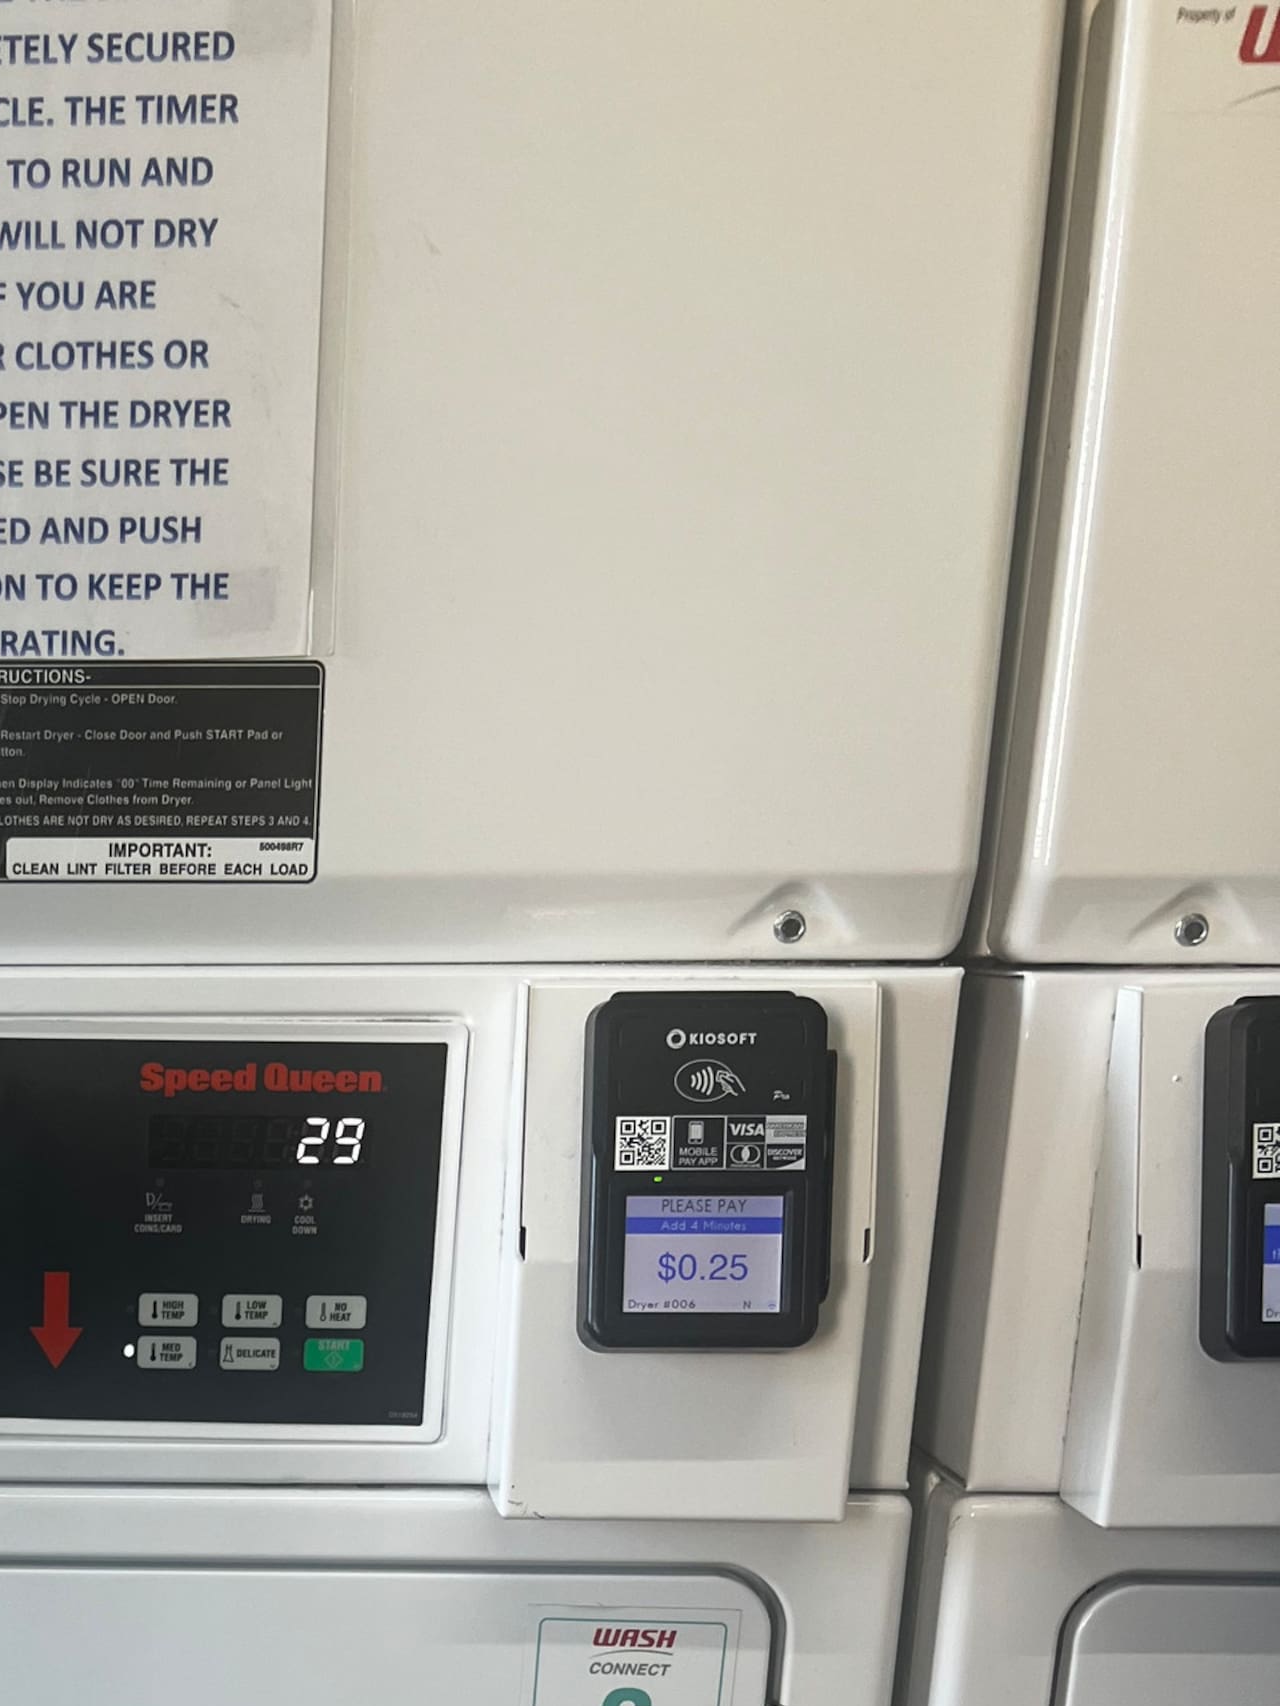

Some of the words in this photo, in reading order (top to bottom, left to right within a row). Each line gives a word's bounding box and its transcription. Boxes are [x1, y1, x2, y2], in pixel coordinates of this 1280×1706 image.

[88, 31, 235, 63] SECURED
[64, 96, 125, 125] THE
[136, 94, 238, 124] TIMER
[7, 159, 50, 188] TO
[63, 158, 130, 187] RUN
[142, 157, 213, 186] AND
[76, 219, 144, 248] NOT
[155, 218, 218, 247] DRY
[16, 281, 84, 310] YOU
[95, 280, 156, 309] ARE
[16, 340, 153, 370] CLOTHES
[164, 340, 208, 368] OR
[59, 401, 118, 428] THE
[130, 400, 230, 427] DRYER
[35, 460, 70, 487] BE
[81, 459, 160, 486] SURE
[170, 458, 228, 486] THE
[40, 517, 108, 544] AND
[120, 516, 201, 543] PUSH
[36, 574, 77, 600] TO
[89, 574, 161, 600] KEEP
[171, 573, 229, 599] THE
[0, 694, 26, 706] Stop
[30, 694, 66, 706] Drying
[70, 693, 101, 706] Cycle
[112, 693, 145, 704] OPEN
[152, 693, 182, 704] Door.
[108, 843, 212, 858] IMPORTANT:
[12, 864, 59, 875] CLEAN
[67, 864, 97, 875] LINT
[105, 864, 151, 875] FILTER
[160, 864, 216, 875] BEFORE
[224, 864, 262, 875] EACH
[270, 864, 308, 875] LOAD
[689, 1033, 757, 1045] KIOSOFT
[140, 1062, 257, 1097] Speed
[264, 1062, 383, 1092] Queen
[730, 1123, 764, 1136] VISA
[296, 1117, 365, 1164] 29
[679, 1148, 718, 1156] MOBILE
[679, 1157, 698, 1166] PAY
[702, 1157, 718, 1165] APP
[661, 1200, 711, 1212] PLEASE
[717, 1200, 747, 1212] PAY
[661, 1221, 686, 1231] Add
[691, 1221, 698, 1231] 4
[704, 1221, 746, 1231] Minutes
[658, 1252, 748, 1282] $0.25
[162, 1302, 184, 1310] HIGH
[246, 1302, 266, 1310] LOW
[335, 1303, 347, 1312] NO
[628, 1299, 658, 1310] Dryer
[664, 1299, 696, 1308] #006
[743, 1300, 751, 1308] N
[162, 1311, 184, 1320] TEMP
[245, 1311, 268, 1320] TEMP
[330, 1312, 351, 1321] HEAT
[162, 1344, 180, 1352] MED
[237, 1349, 276, 1358] DELICATE
[160, 1353, 182, 1362] TEMP
[593, 1629, 677, 1648] WASH
[589, 1662, 671, 1676] CONNECT
